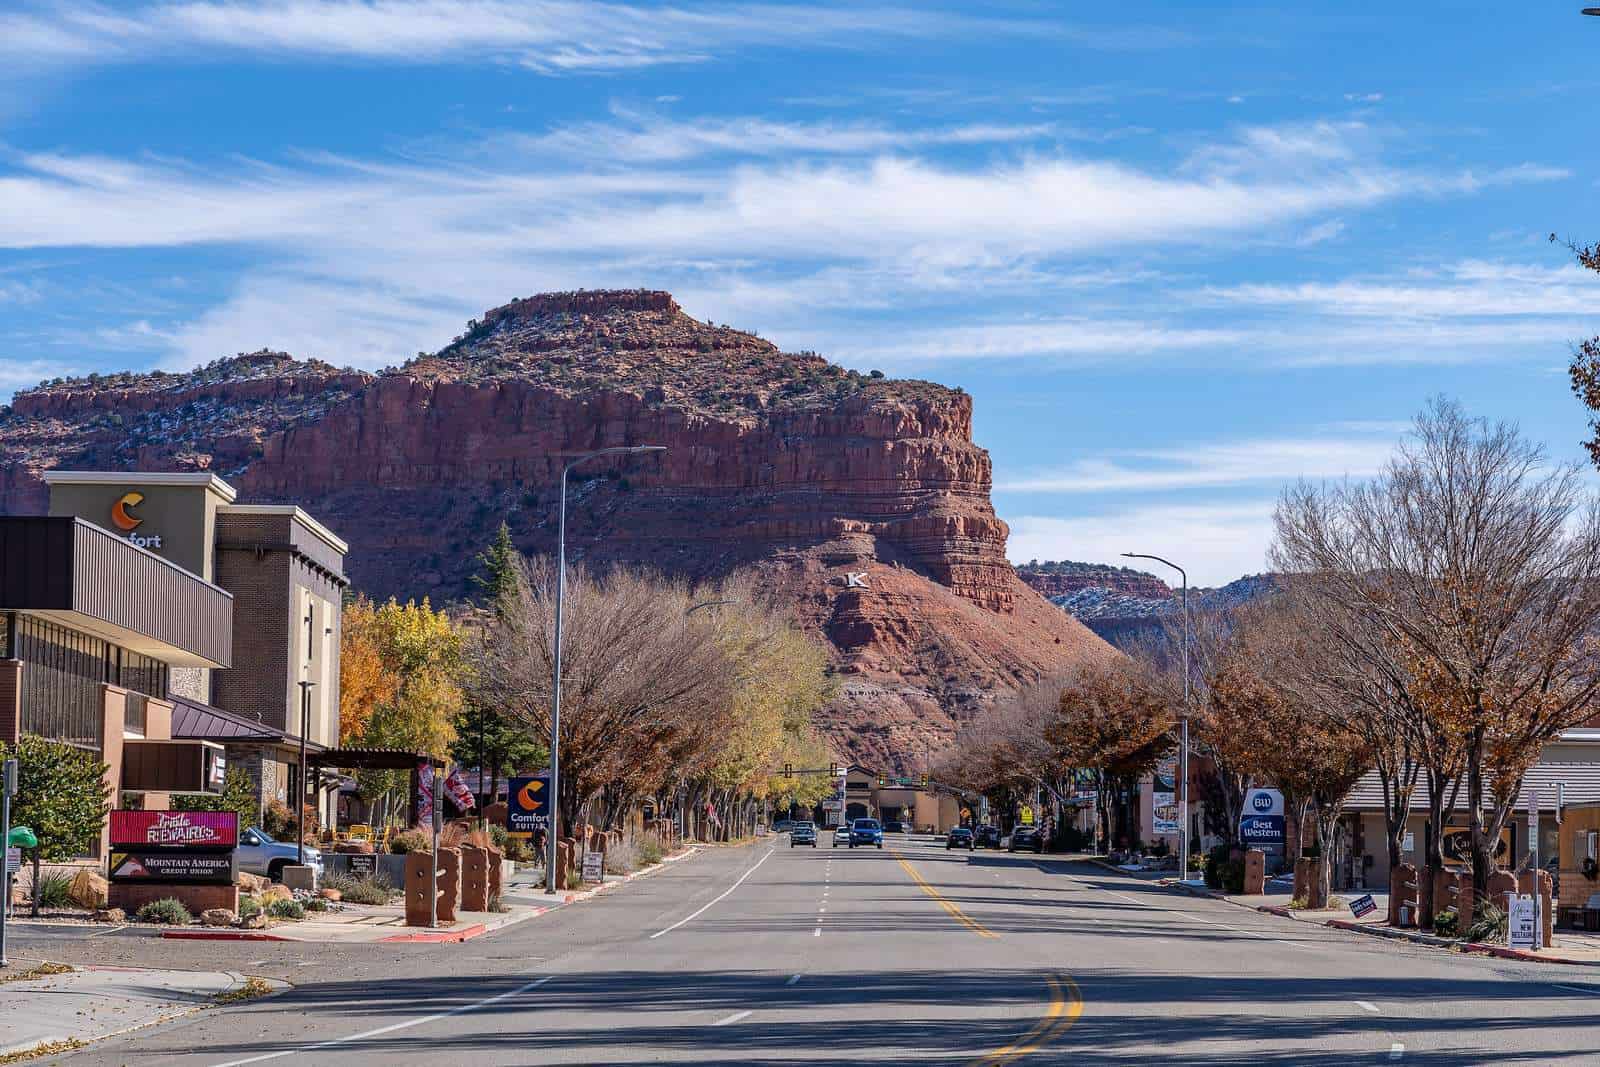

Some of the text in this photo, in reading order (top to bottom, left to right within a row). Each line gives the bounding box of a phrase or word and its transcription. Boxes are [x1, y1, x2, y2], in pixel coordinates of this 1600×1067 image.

[1254, 798, 1271, 807] BW
[1252, 820, 1273, 829] Best
[1244, 828, 1281, 837] Western
[193, 858, 230, 868] AMERICA
